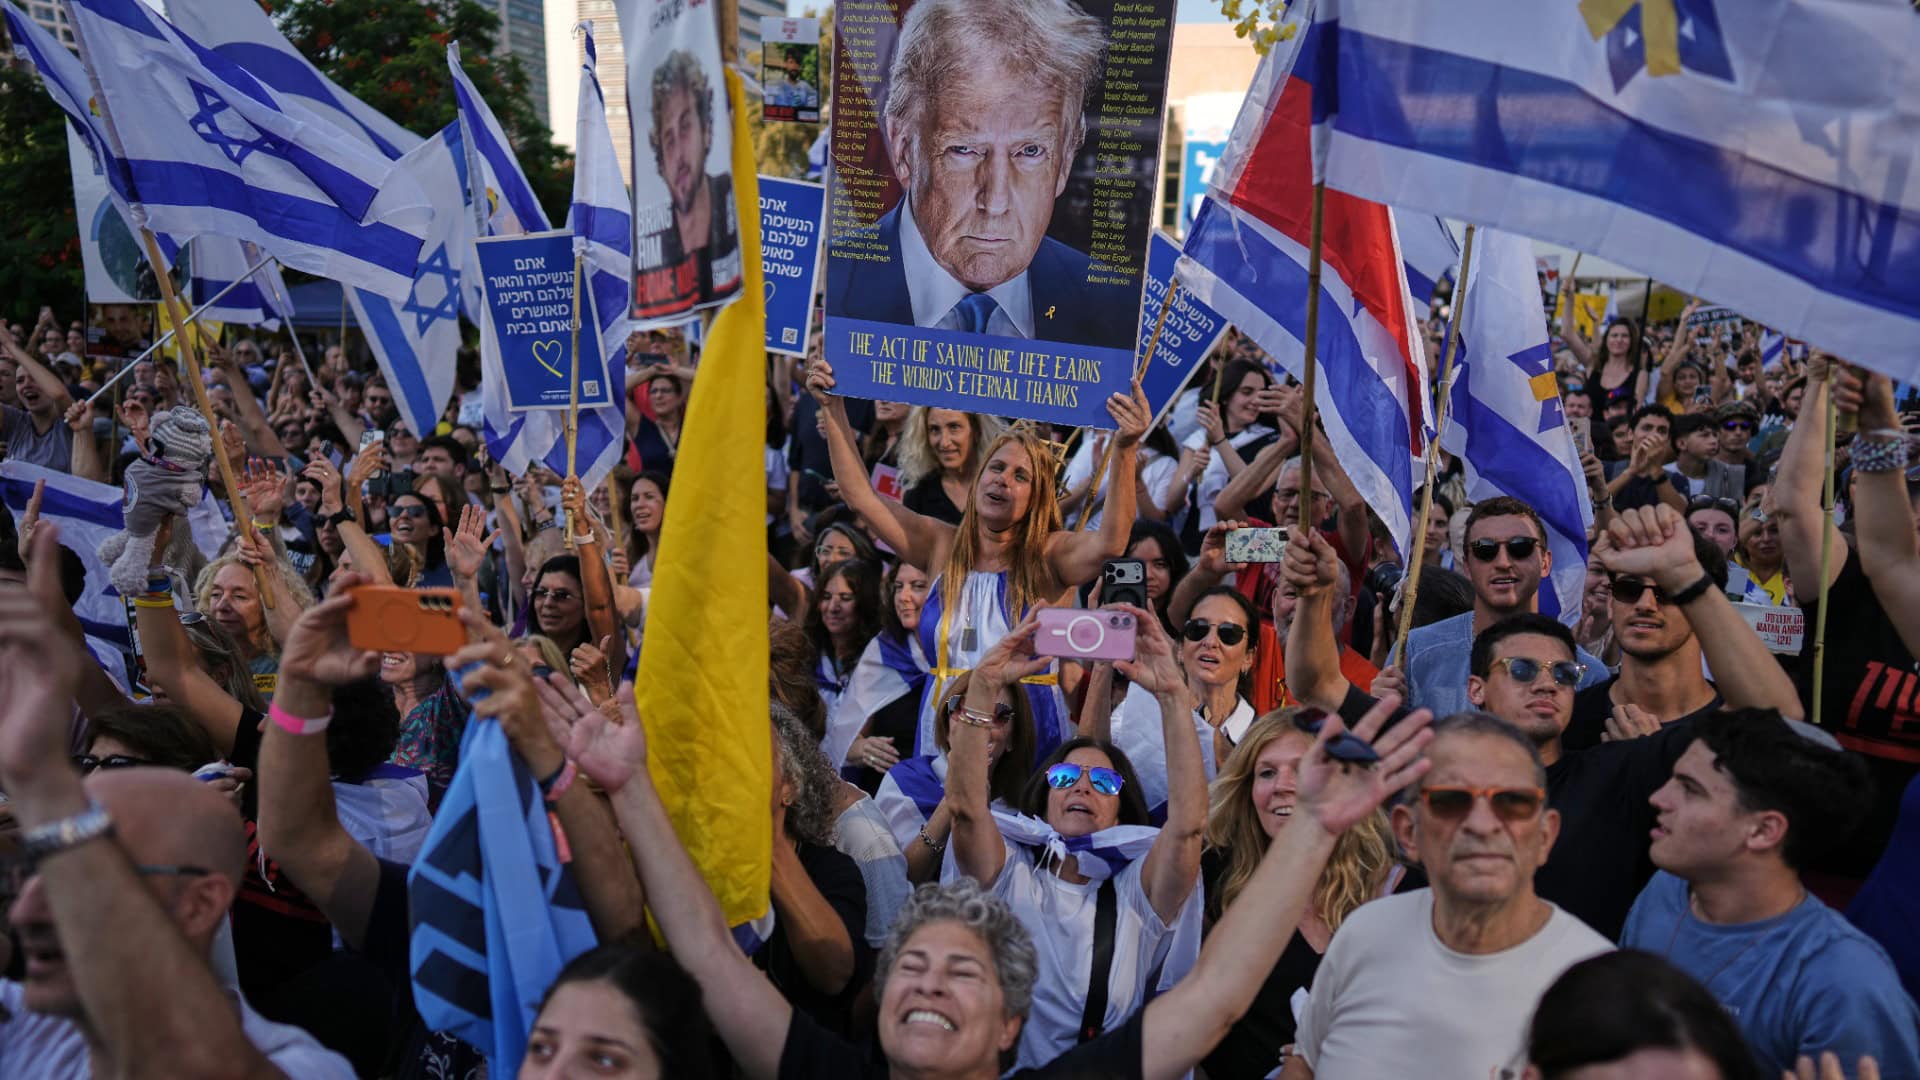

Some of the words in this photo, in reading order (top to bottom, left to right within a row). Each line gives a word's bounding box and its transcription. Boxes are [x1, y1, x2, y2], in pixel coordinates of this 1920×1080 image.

[1114, 3, 1134, 12] David
[1138, 17, 1166, 29] Margalit
[1110, 30, 1128, 39] Asaf
[1130, 42, 1156, 52] Baruch
[1106, 67, 1120, 78] Guy
[1105, 80, 1114, 89] Tal
[1102, 104, 1124, 115] Manny
[1125, 105, 1155, 114] Goddard
[1100, 116, 1122, 125] Daniel
[1114, 128, 1132, 138] Chen
[1098, 141, 1120, 150] Hadar
[1096, 153, 1107, 162] Oz
[856, 168, 874, 176] David
[1093, 208, 1107, 217] Ran
[763, 214, 814, 233] הנשימה
[768, 230, 809, 248] שלהם
[1109, 232, 1126, 242] Levy
[761, 246, 794, 261] מאוש
[1112, 253, 1132, 264] Engel
[514, 257, 546, 271] אתם
[762, 261, 802, 278] שאתם
[1113, 264, 1138, 275] Cooper
[489, 274, 524, 289] והאור
[527, 270, 576, 286] הנשימה
[537, 286, 575, 302] שלהם
[511, 304, 569, 320] מאושרים
[506, 322, 537, 336] בבית
[849, 331, 875, 356] THE
[879, 335, 908, 360] ACT
[912, 339, 932, 363] OF
[936, 341, 984, 372] SAVING
[988, 347, 1014, 374] ONE
[1018, 351, 1050, 378] LIFE
[1054, 355, 1102, 384] EARNS
[870, 360, 896, 386] THE
[902, 364, 953, 392] WORLD'S
[958, 371, 1020, 402] ETERNAL
[1024, 379, 1079, 408] THANKS
